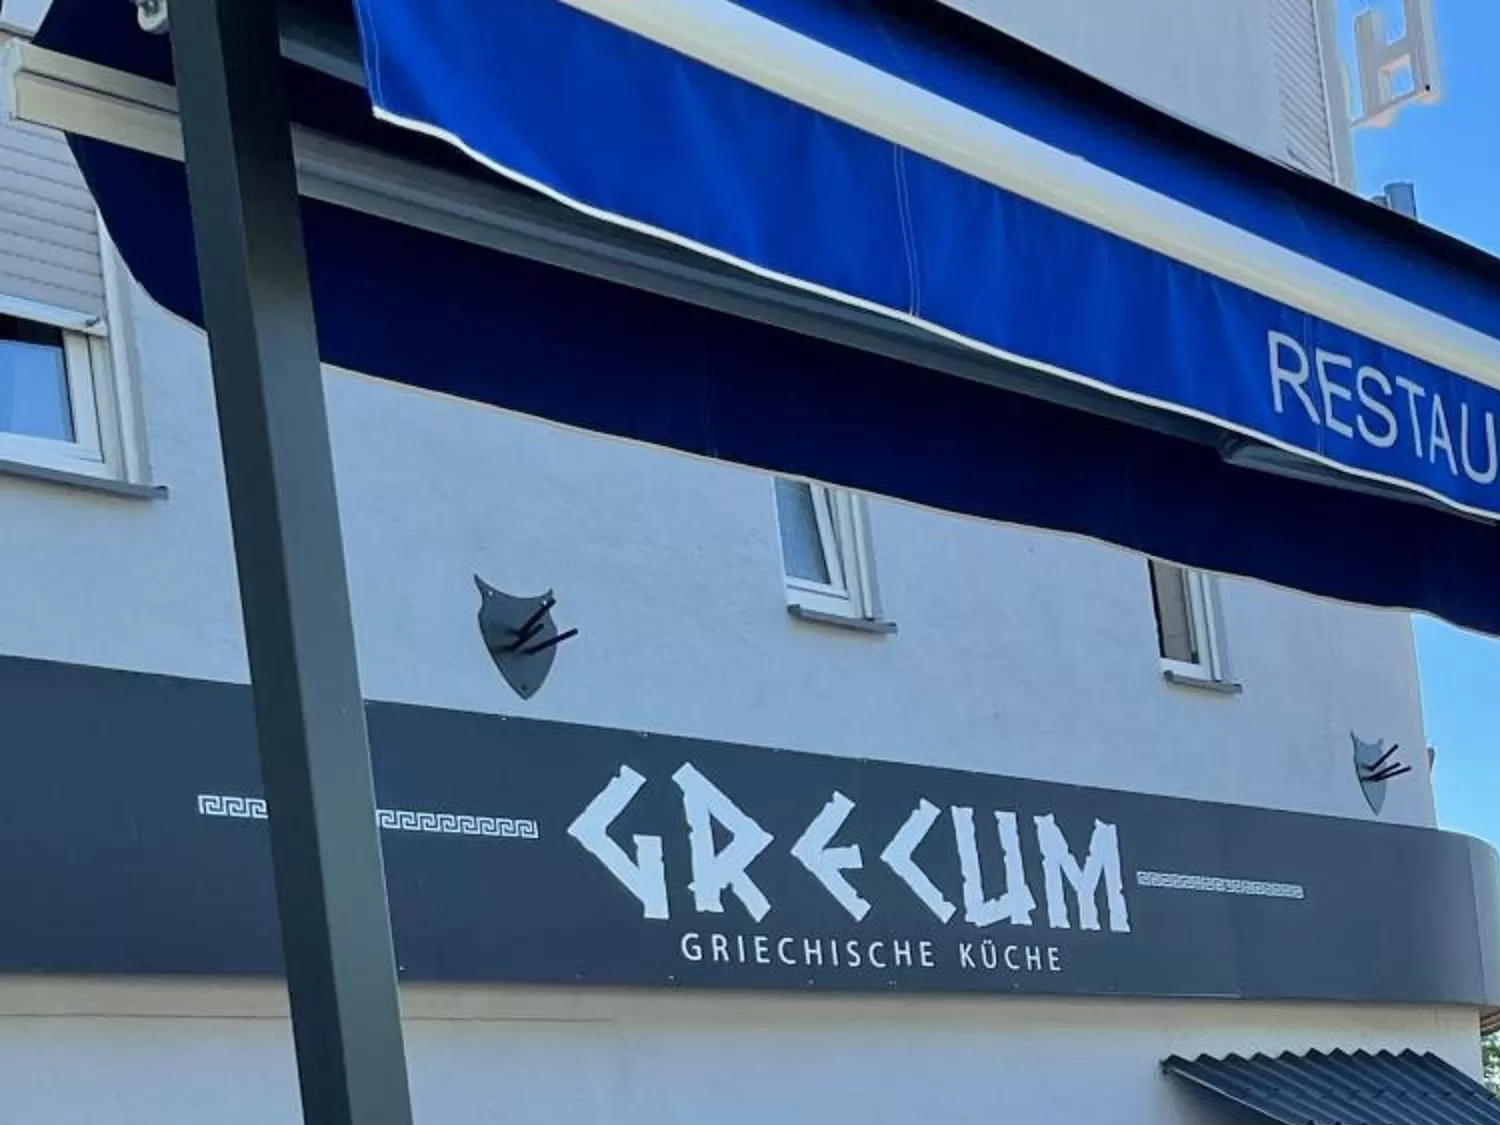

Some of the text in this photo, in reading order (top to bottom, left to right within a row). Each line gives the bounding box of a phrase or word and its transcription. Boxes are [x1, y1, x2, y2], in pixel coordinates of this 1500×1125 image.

[566, 761, 1131, 933] GRECUM
[680, 932, 1062, 972] GRIECHISCHE KÜCHE
